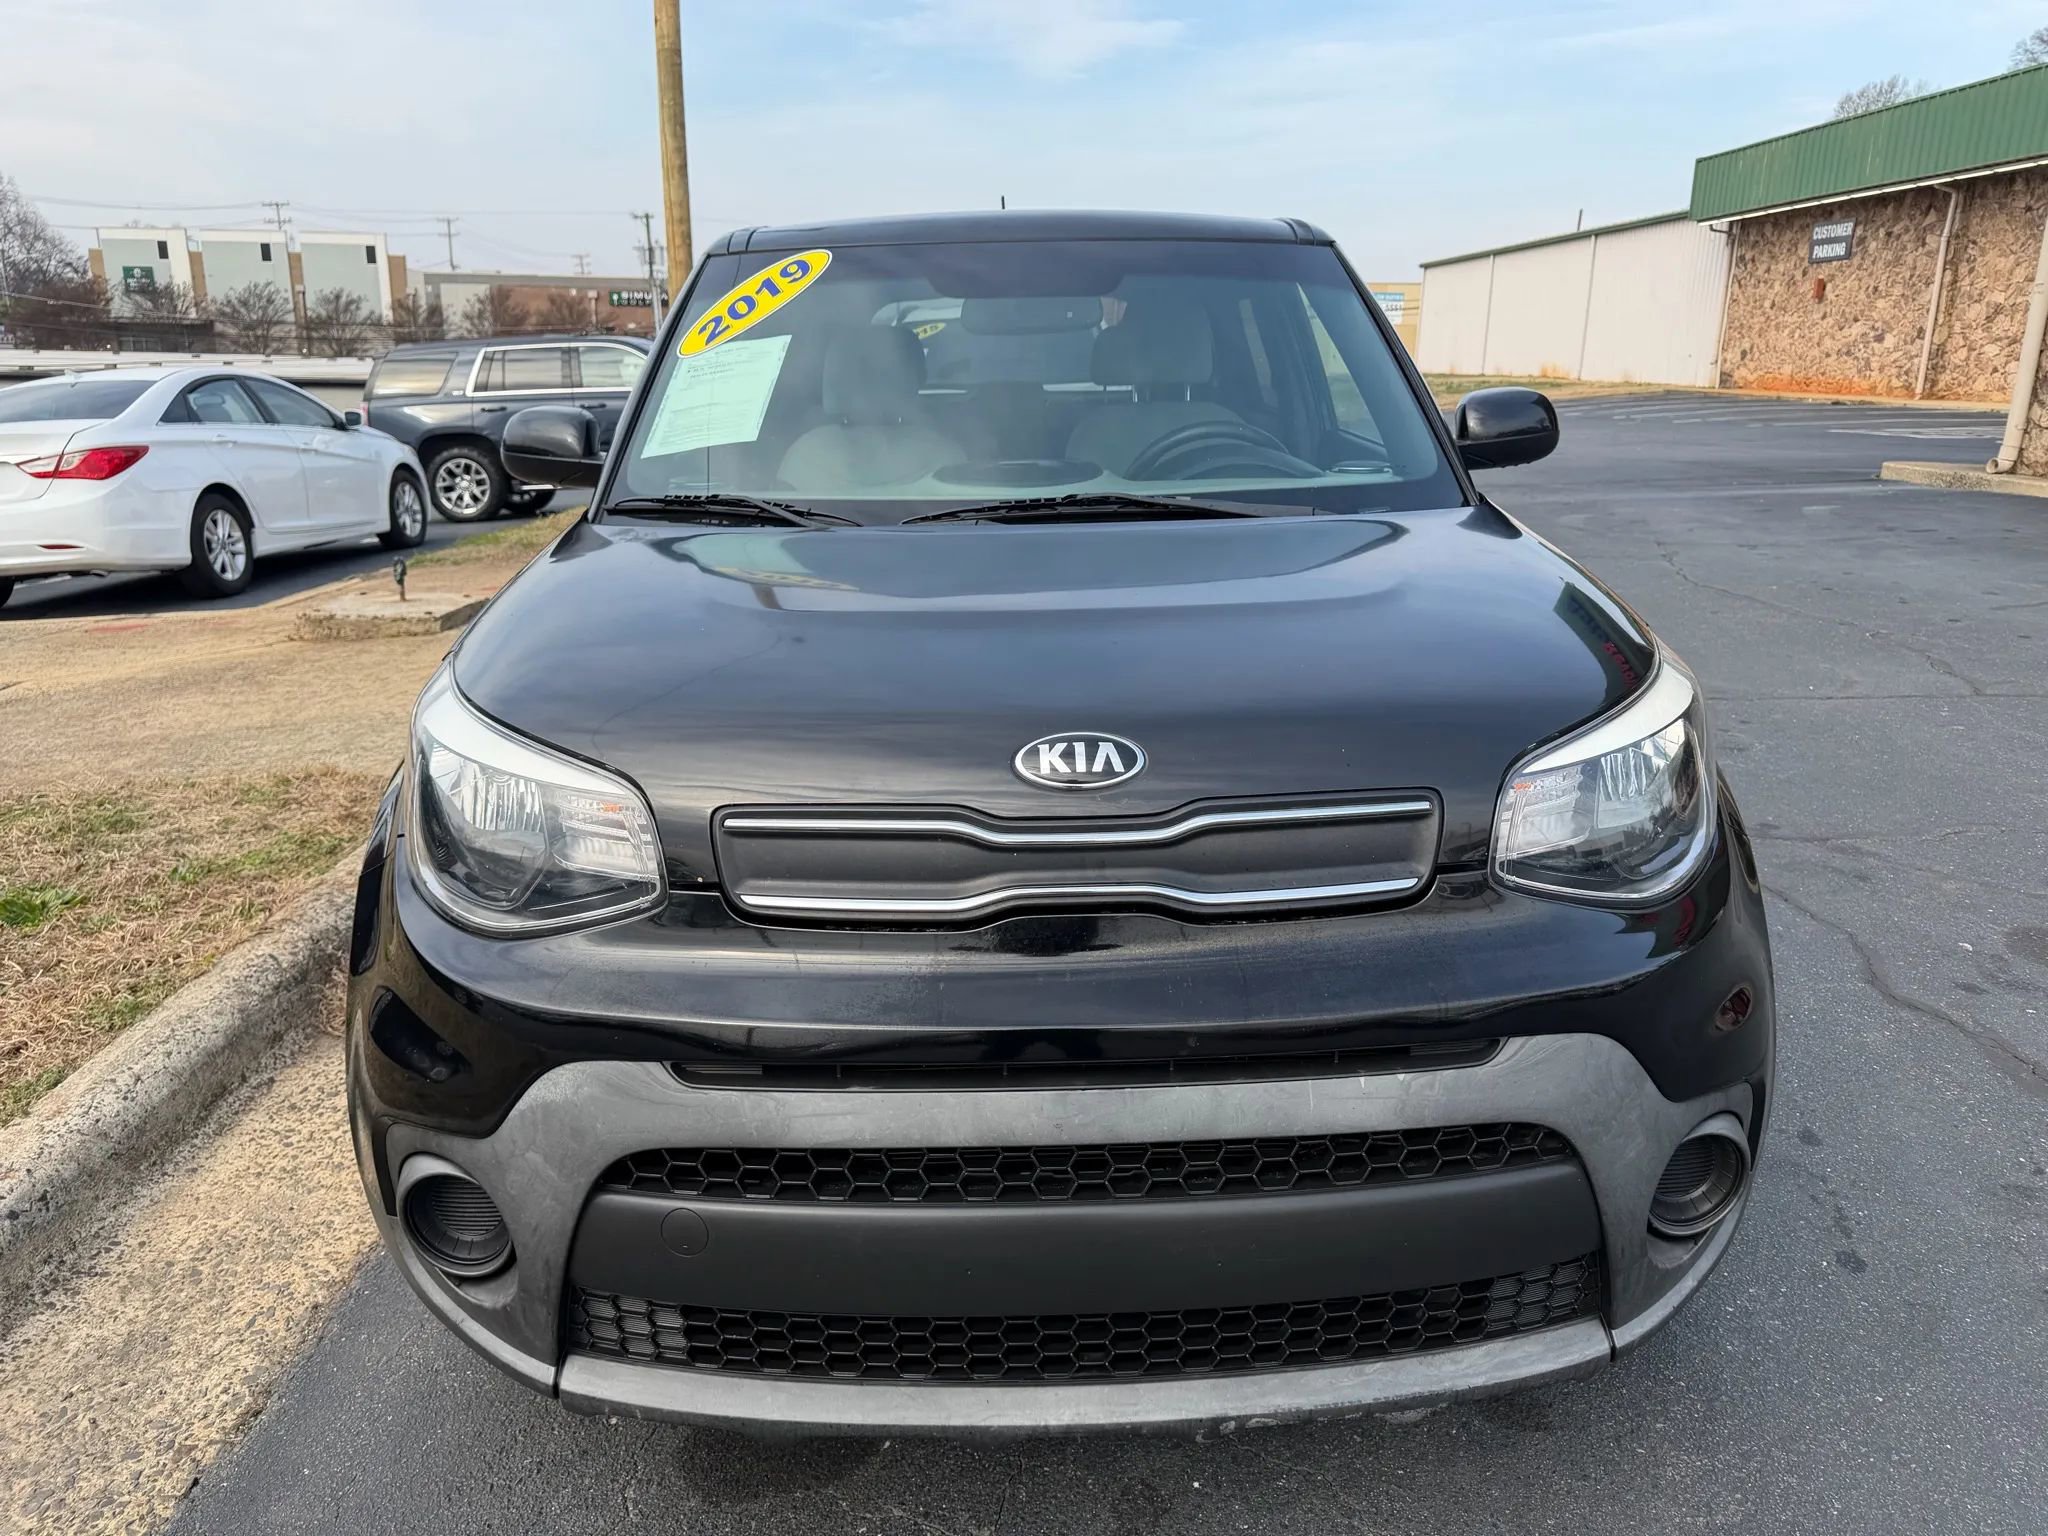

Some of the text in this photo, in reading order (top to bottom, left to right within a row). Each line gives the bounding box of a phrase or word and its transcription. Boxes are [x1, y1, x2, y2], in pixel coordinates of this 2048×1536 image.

[1812, 222, 1854, 240] CUSTOMER
[1812, 242, 1847, 259] PARKING
[697, 259, 813, 347] 2019
[1037, 741, 1125, 775] KIA
